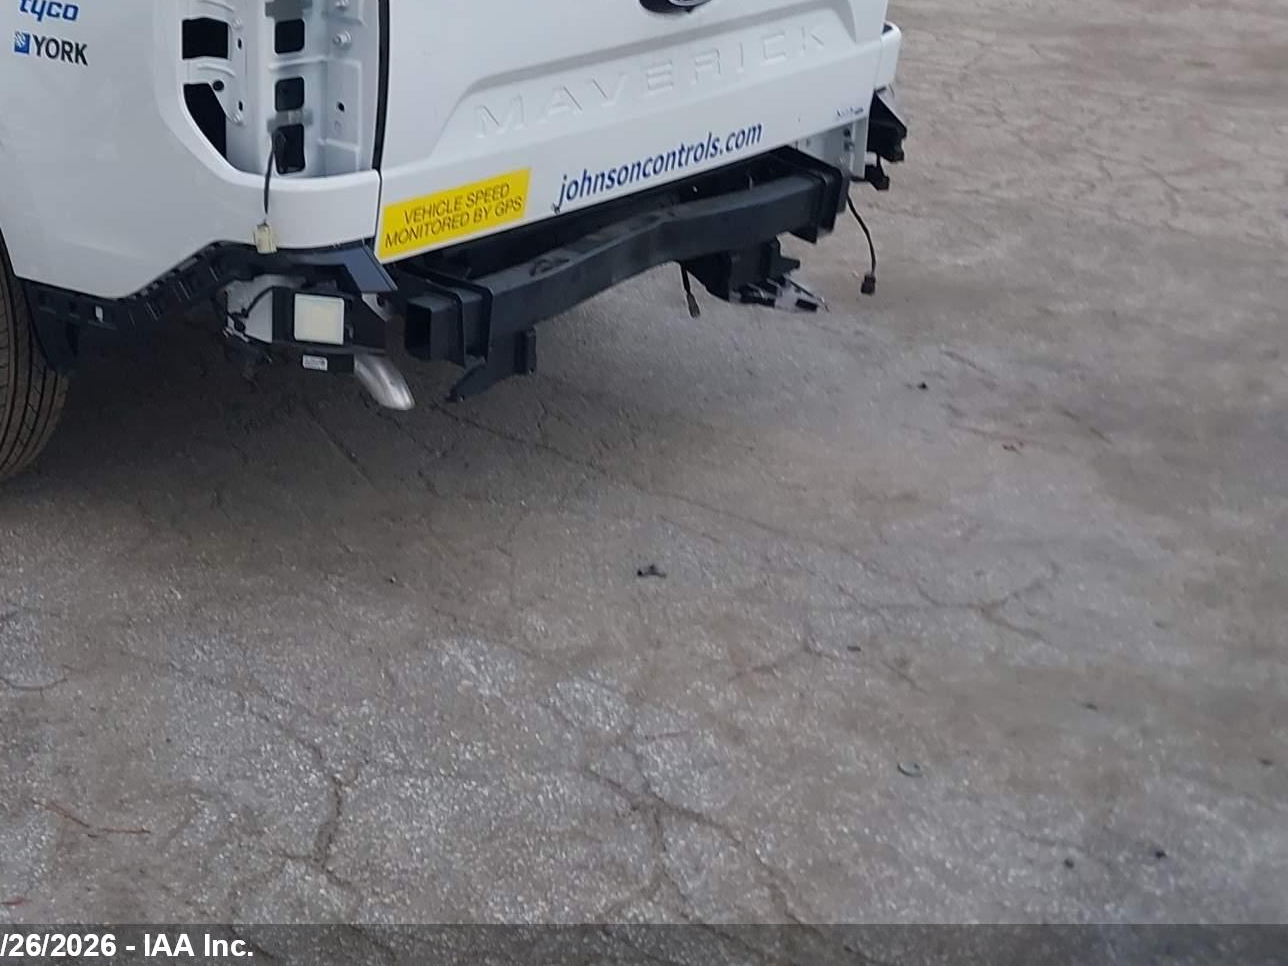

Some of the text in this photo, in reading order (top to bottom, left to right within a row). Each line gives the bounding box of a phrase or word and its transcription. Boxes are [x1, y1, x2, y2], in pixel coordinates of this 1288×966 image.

[32, 35, 88, 66] YORK
[475, 26, 825, 138] MAVERICK
[558, 123, 762, 208] johnsoncontrols.com
[384, 196, 524, 249] MONITORED BY GPS
[404, 183, 510, 225] VEHICLE SPEED
